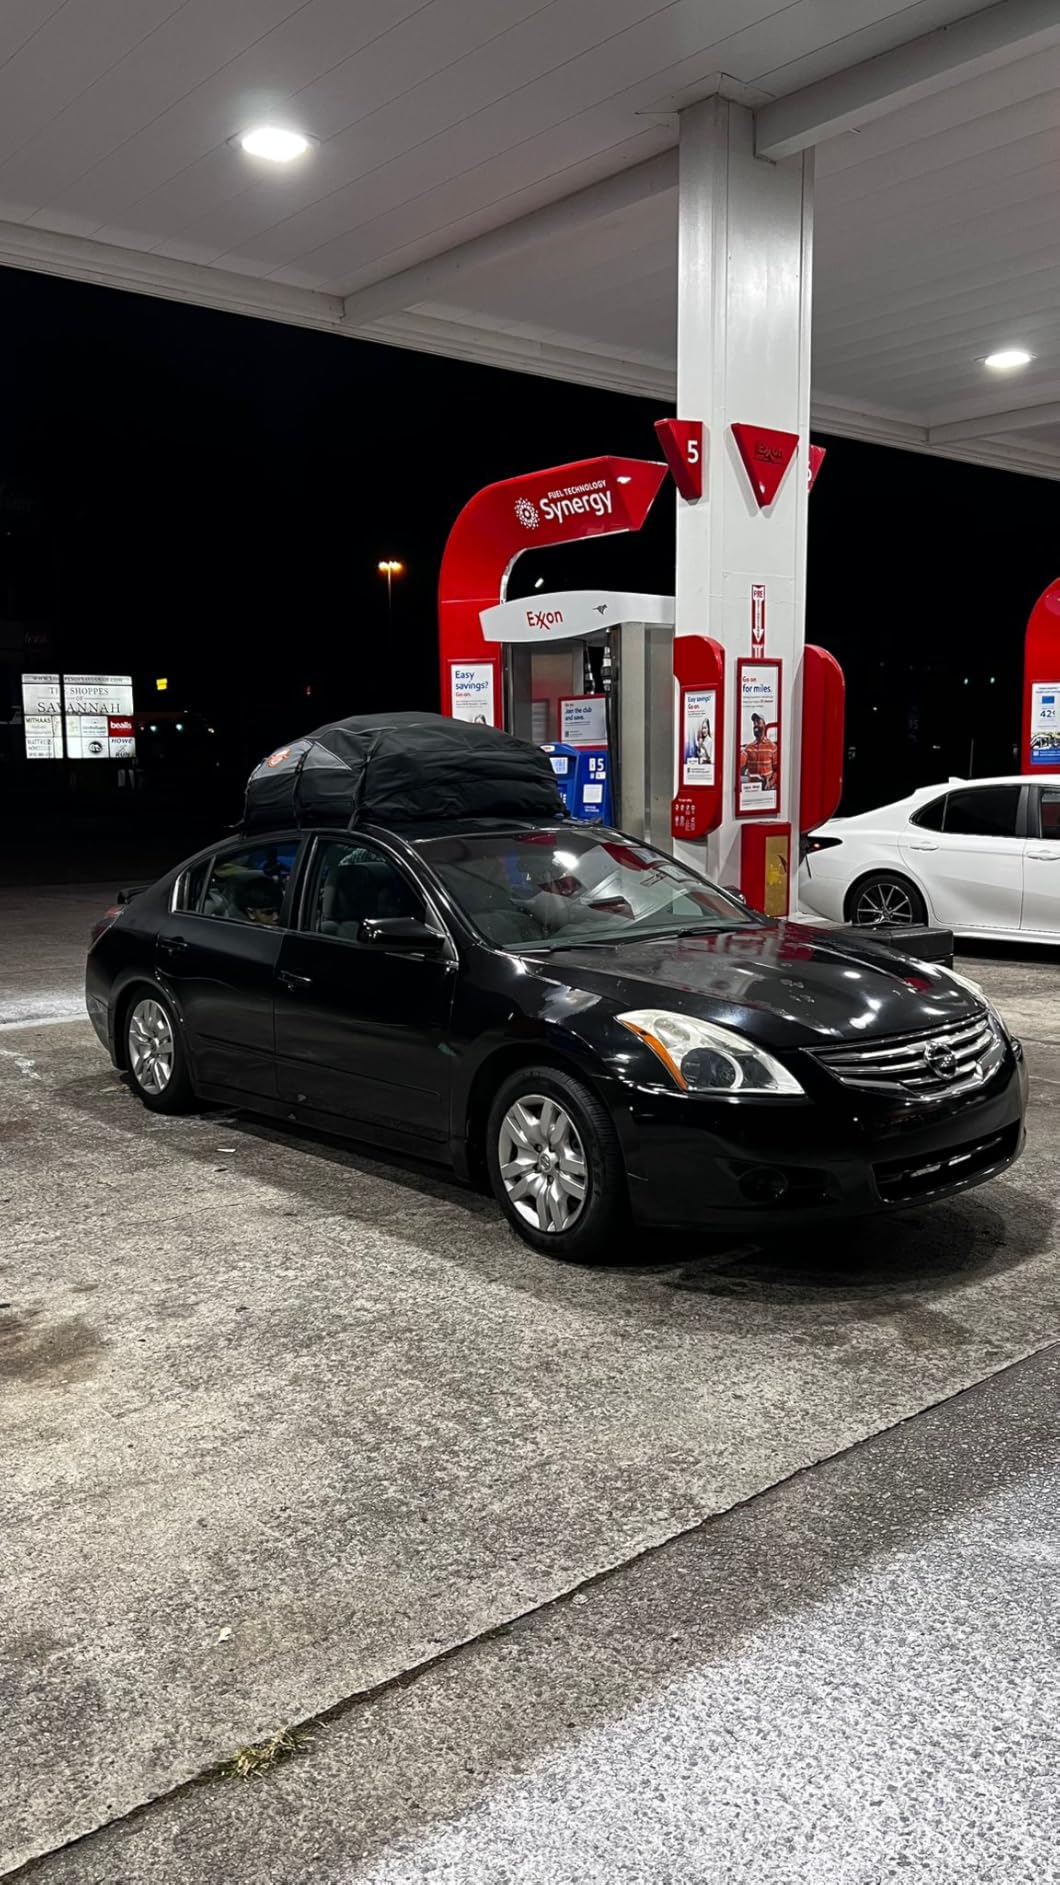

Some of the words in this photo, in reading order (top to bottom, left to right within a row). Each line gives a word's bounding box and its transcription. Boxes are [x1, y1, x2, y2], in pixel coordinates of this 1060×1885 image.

[687, 440, 699, 463] 5
[548, 489, 563, 500] FUEL
[566, 479, 607, 496] TECHNOLOGY
[540, 491, 613, 523] Synergy
[526, 610, 563, 630] Exxon
[455, 670, 475, 680] Easy
[70, 687, 109, 696] SHOPPES
[455, 681, 489, 691] savings?
[743, 684, 752, 693] for
[597, 758, 605, 771] 5
